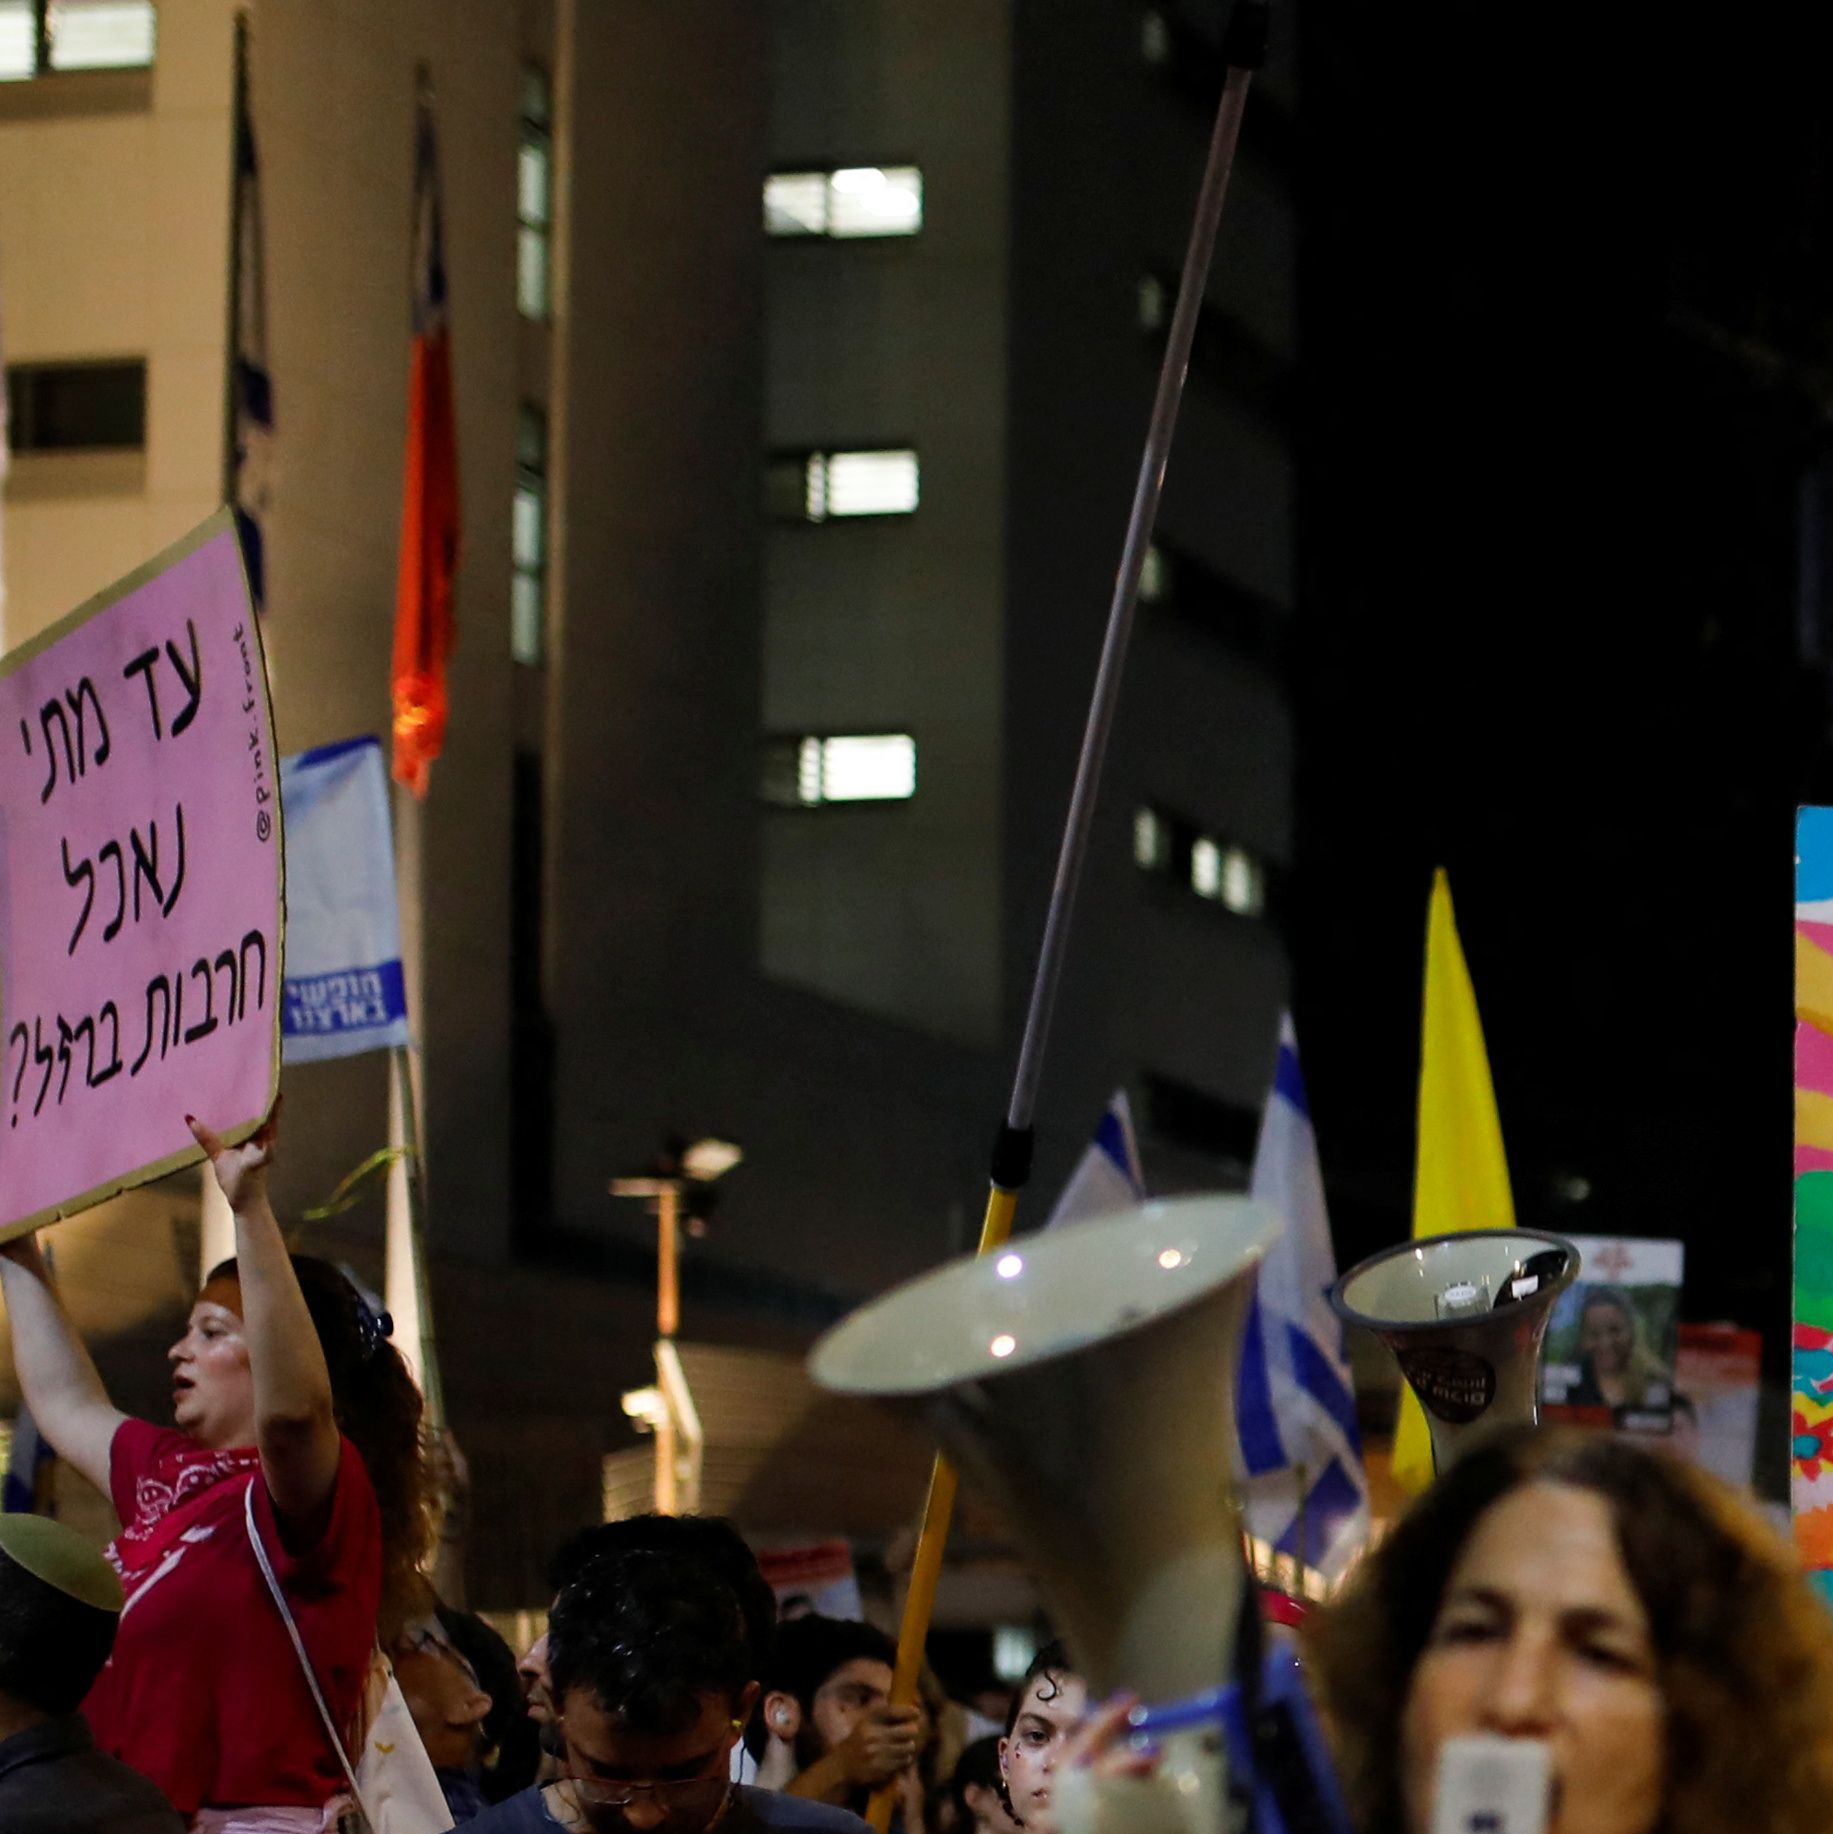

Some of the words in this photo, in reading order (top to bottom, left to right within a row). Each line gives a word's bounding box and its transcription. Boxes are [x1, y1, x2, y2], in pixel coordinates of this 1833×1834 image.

[20, 676, 111, 804] מתי
[123, 618, 203, 742] עד
[60, 803, 187, 955] נאכל
[130, 929, 267, 1076] חרבות
